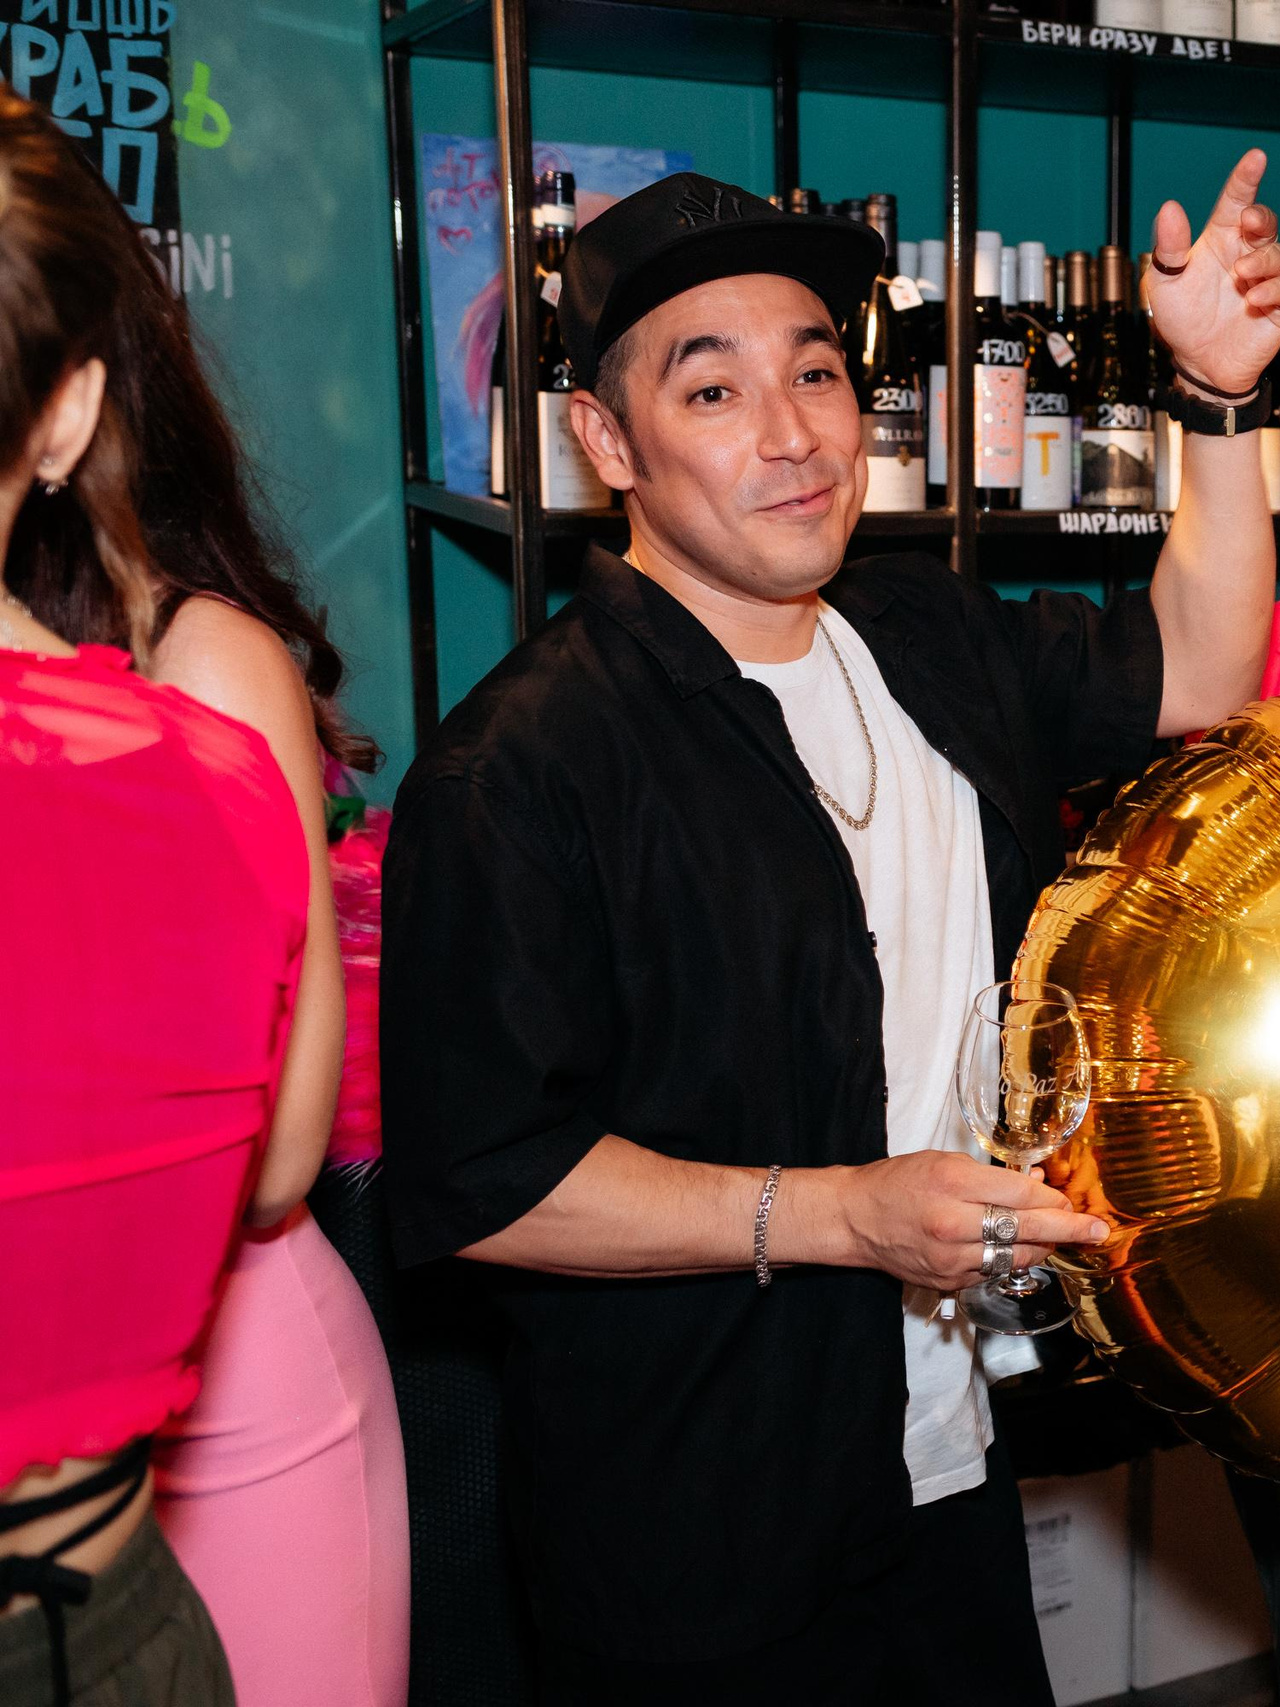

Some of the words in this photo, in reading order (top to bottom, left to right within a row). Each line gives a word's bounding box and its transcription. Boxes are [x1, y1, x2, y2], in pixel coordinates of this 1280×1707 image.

[1021, 19, 1081, 47] БЕРИ
[1088, 28, 1157, 56] СРАЗУ
[1171, 37, 1232, 62] ДВЕ!
[0, 22, 170, 128] РАБ
[981, 339, 1025, 364] 1700
